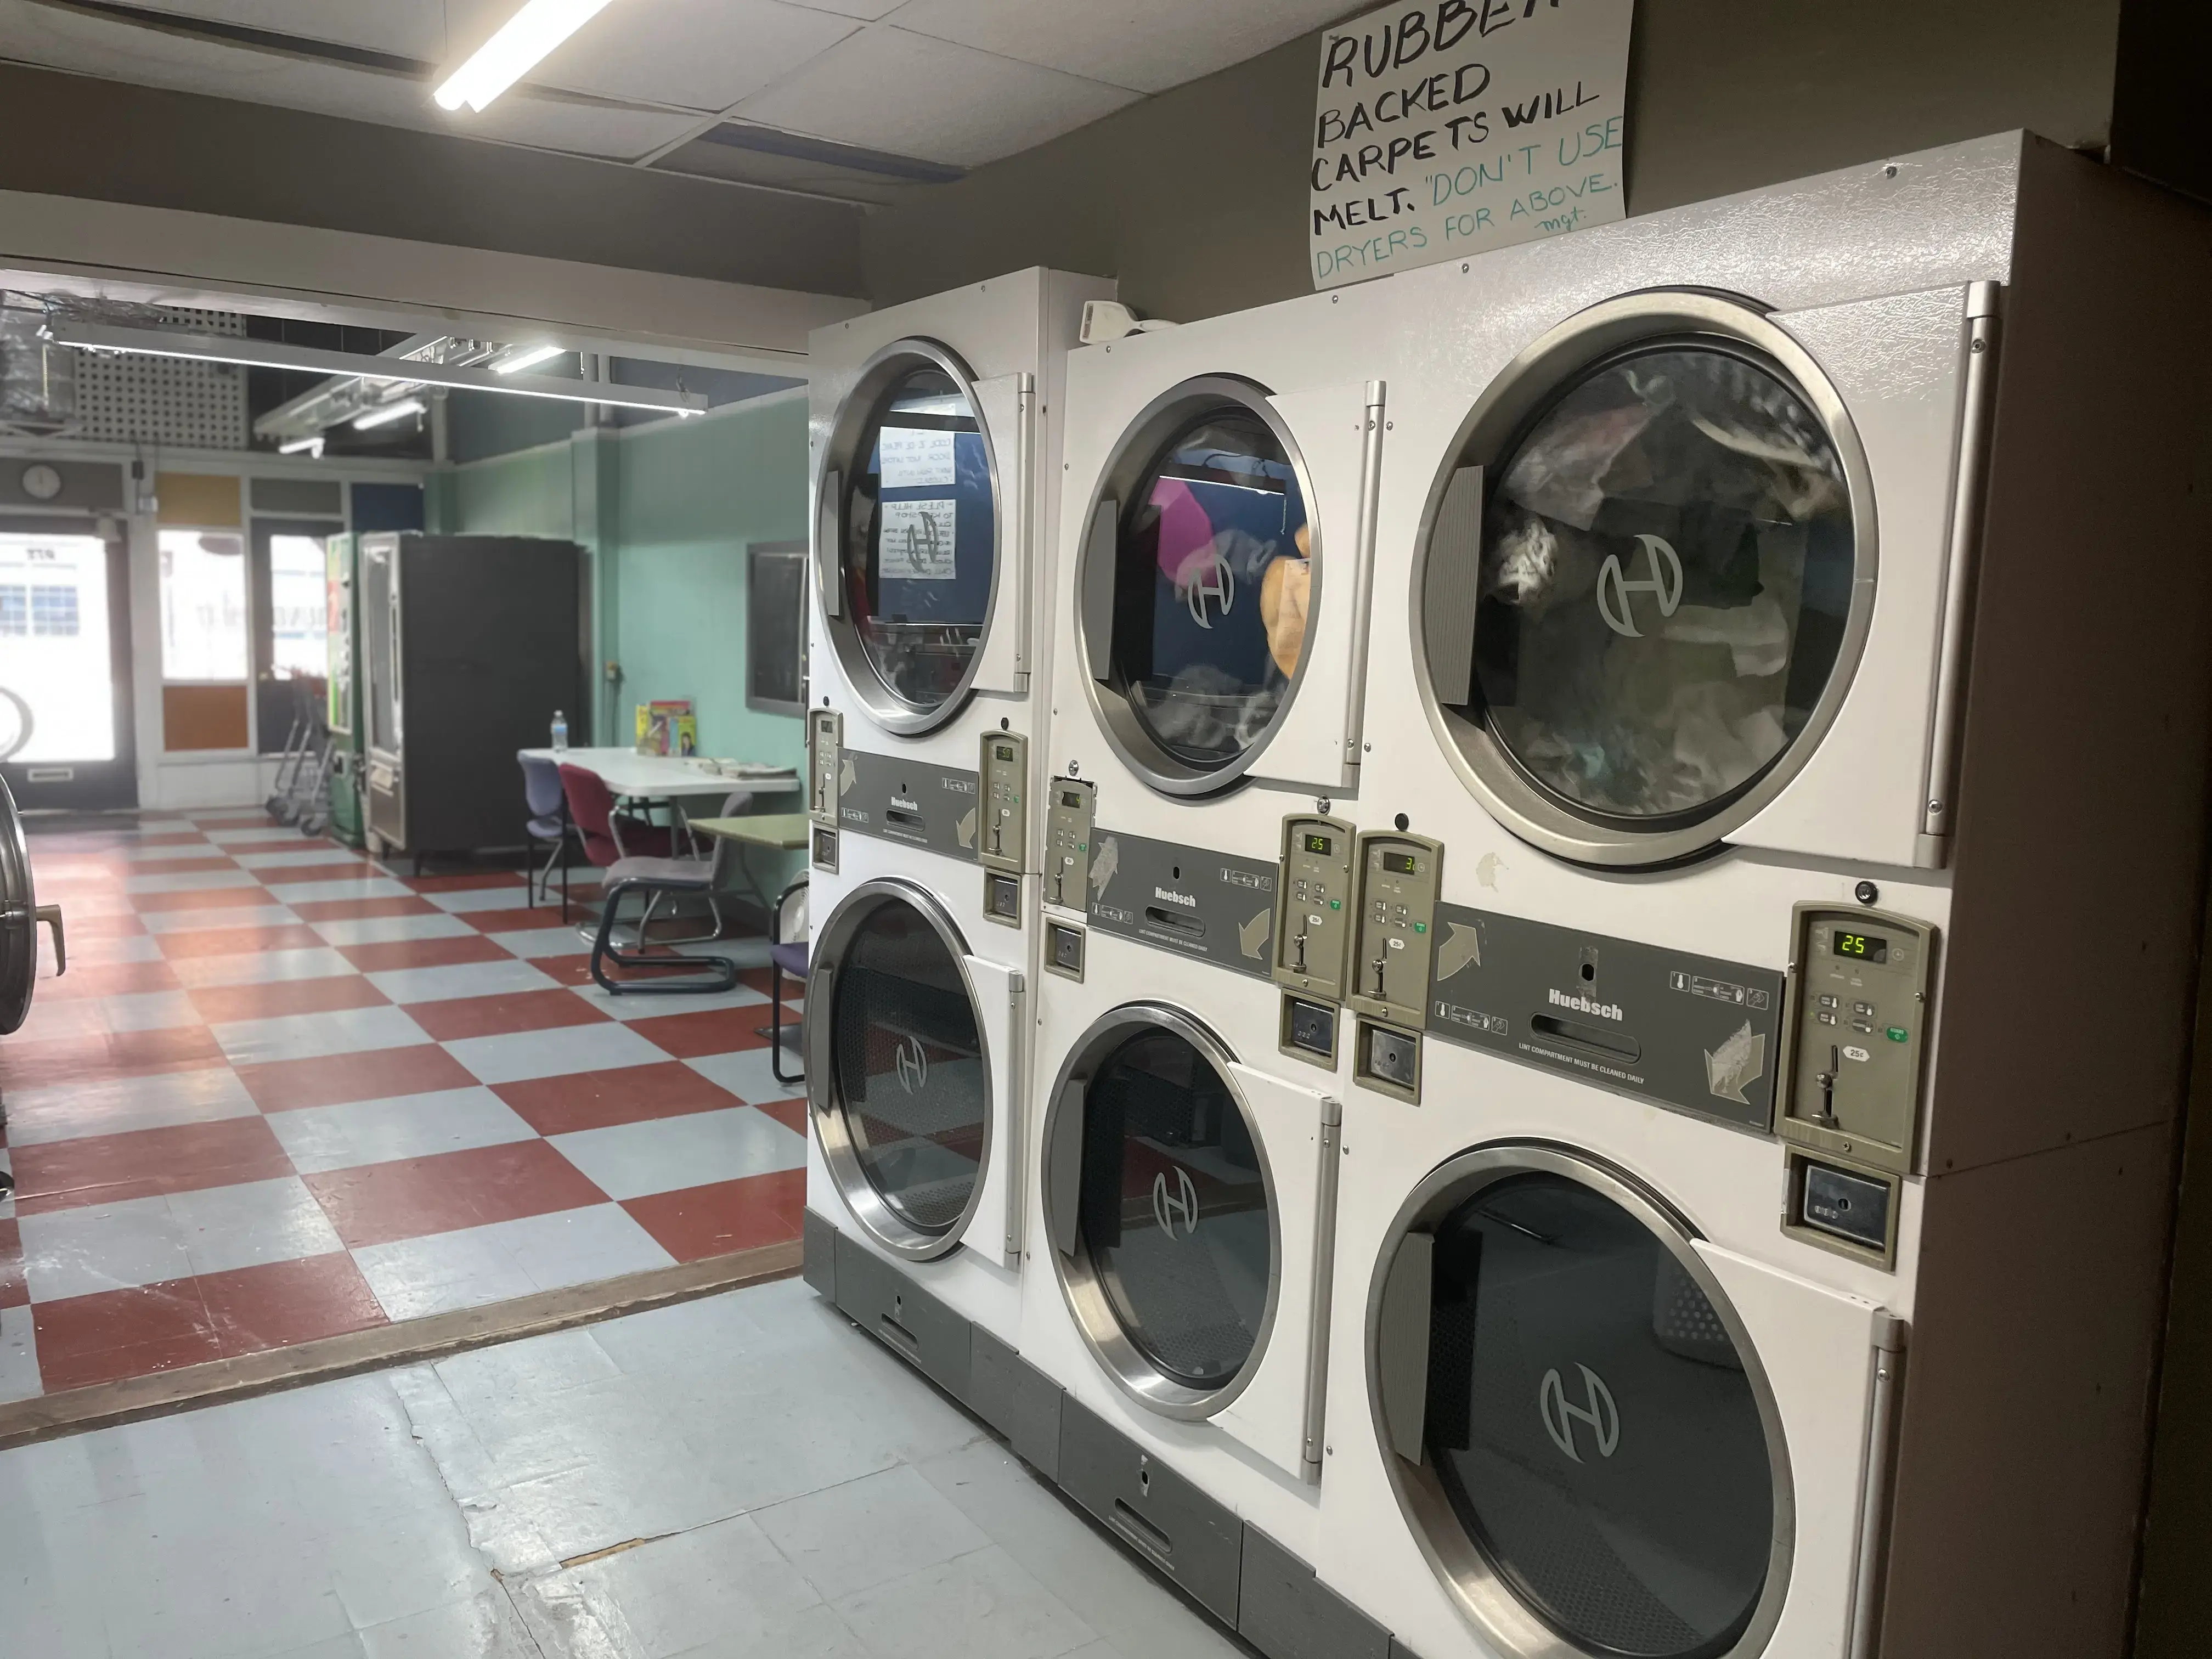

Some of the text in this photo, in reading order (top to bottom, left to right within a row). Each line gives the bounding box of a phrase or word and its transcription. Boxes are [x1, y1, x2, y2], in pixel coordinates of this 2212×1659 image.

[1318, 63, 1491, 149] BACKED
[1311, 81, 1600, 191] CARPETS WILL
[1313, 187, 1415, 236] MELT.
[1559, 115, 1623, 166] USE
[1316, 173, 1618, 279] DRYERS FOR ABOVE.
[1311, 837, 1323, 850] 25
[1155, 887, 1196, 907] Huebsch
[1841, 935, 1865, 954] 25
[1548, 988, 1623, 1022] Huebsch
[1519, 1042, 1645, 1085] LINT COMPARTMENT MUST BE CLEANED DAILY
[1850, 1049, 1864, 1058] 25¢
